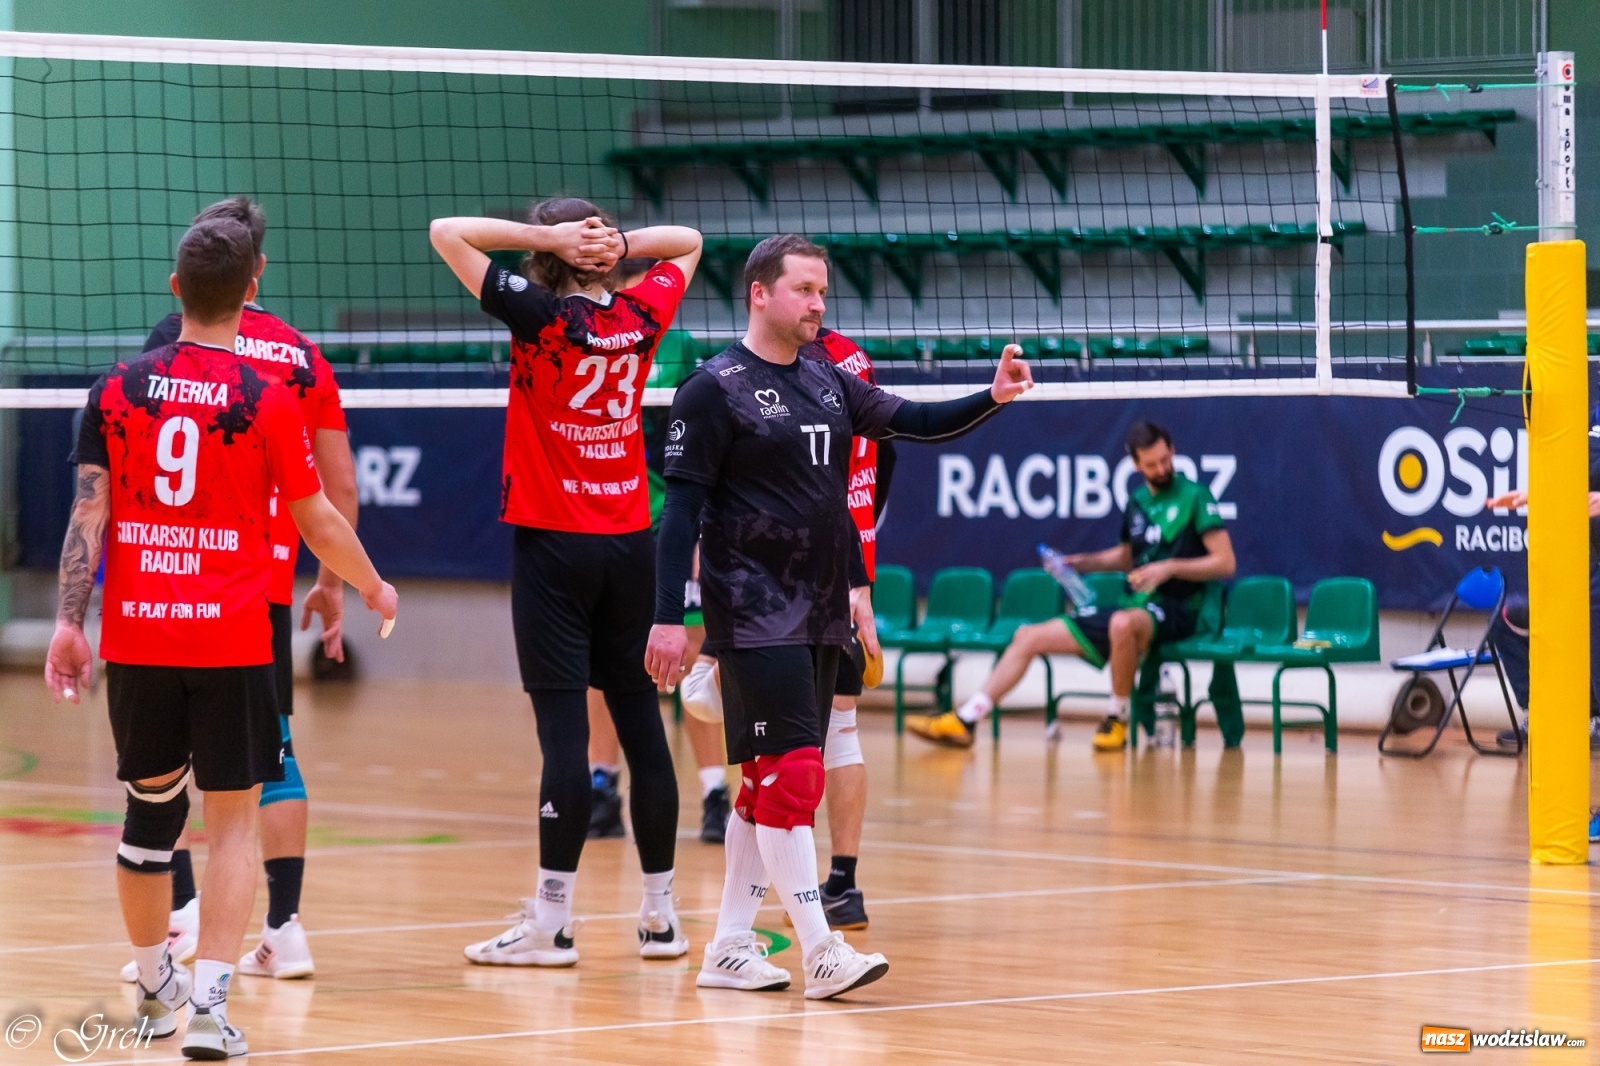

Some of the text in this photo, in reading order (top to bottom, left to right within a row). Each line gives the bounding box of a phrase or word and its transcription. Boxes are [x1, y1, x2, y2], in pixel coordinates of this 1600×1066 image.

[234, 335, 309, 369] BARCZYK
[147, 375, 228, 407] TATERKA
[568, 354, 639, 419] 23
[760, 403, 789, 416] radlin
[800, 424, 831, 465] 77
[154, 416, 200, 507] 9
[1378, 426, 1528, 517] OSi
[562, 479, 578, 494] WE
[937, 454, 1238, 520] RACIBZ
[198, 527, 239, 551] KLUB
[1456, 525, 1528, 552] RACIB
[140, 549, 201, 575] RADLIN
[122, 601, 221, 619] WE PLAY FOR FUN
[750, 885, 769, 898] TIC
[794, 890, 819, 904] TICO
